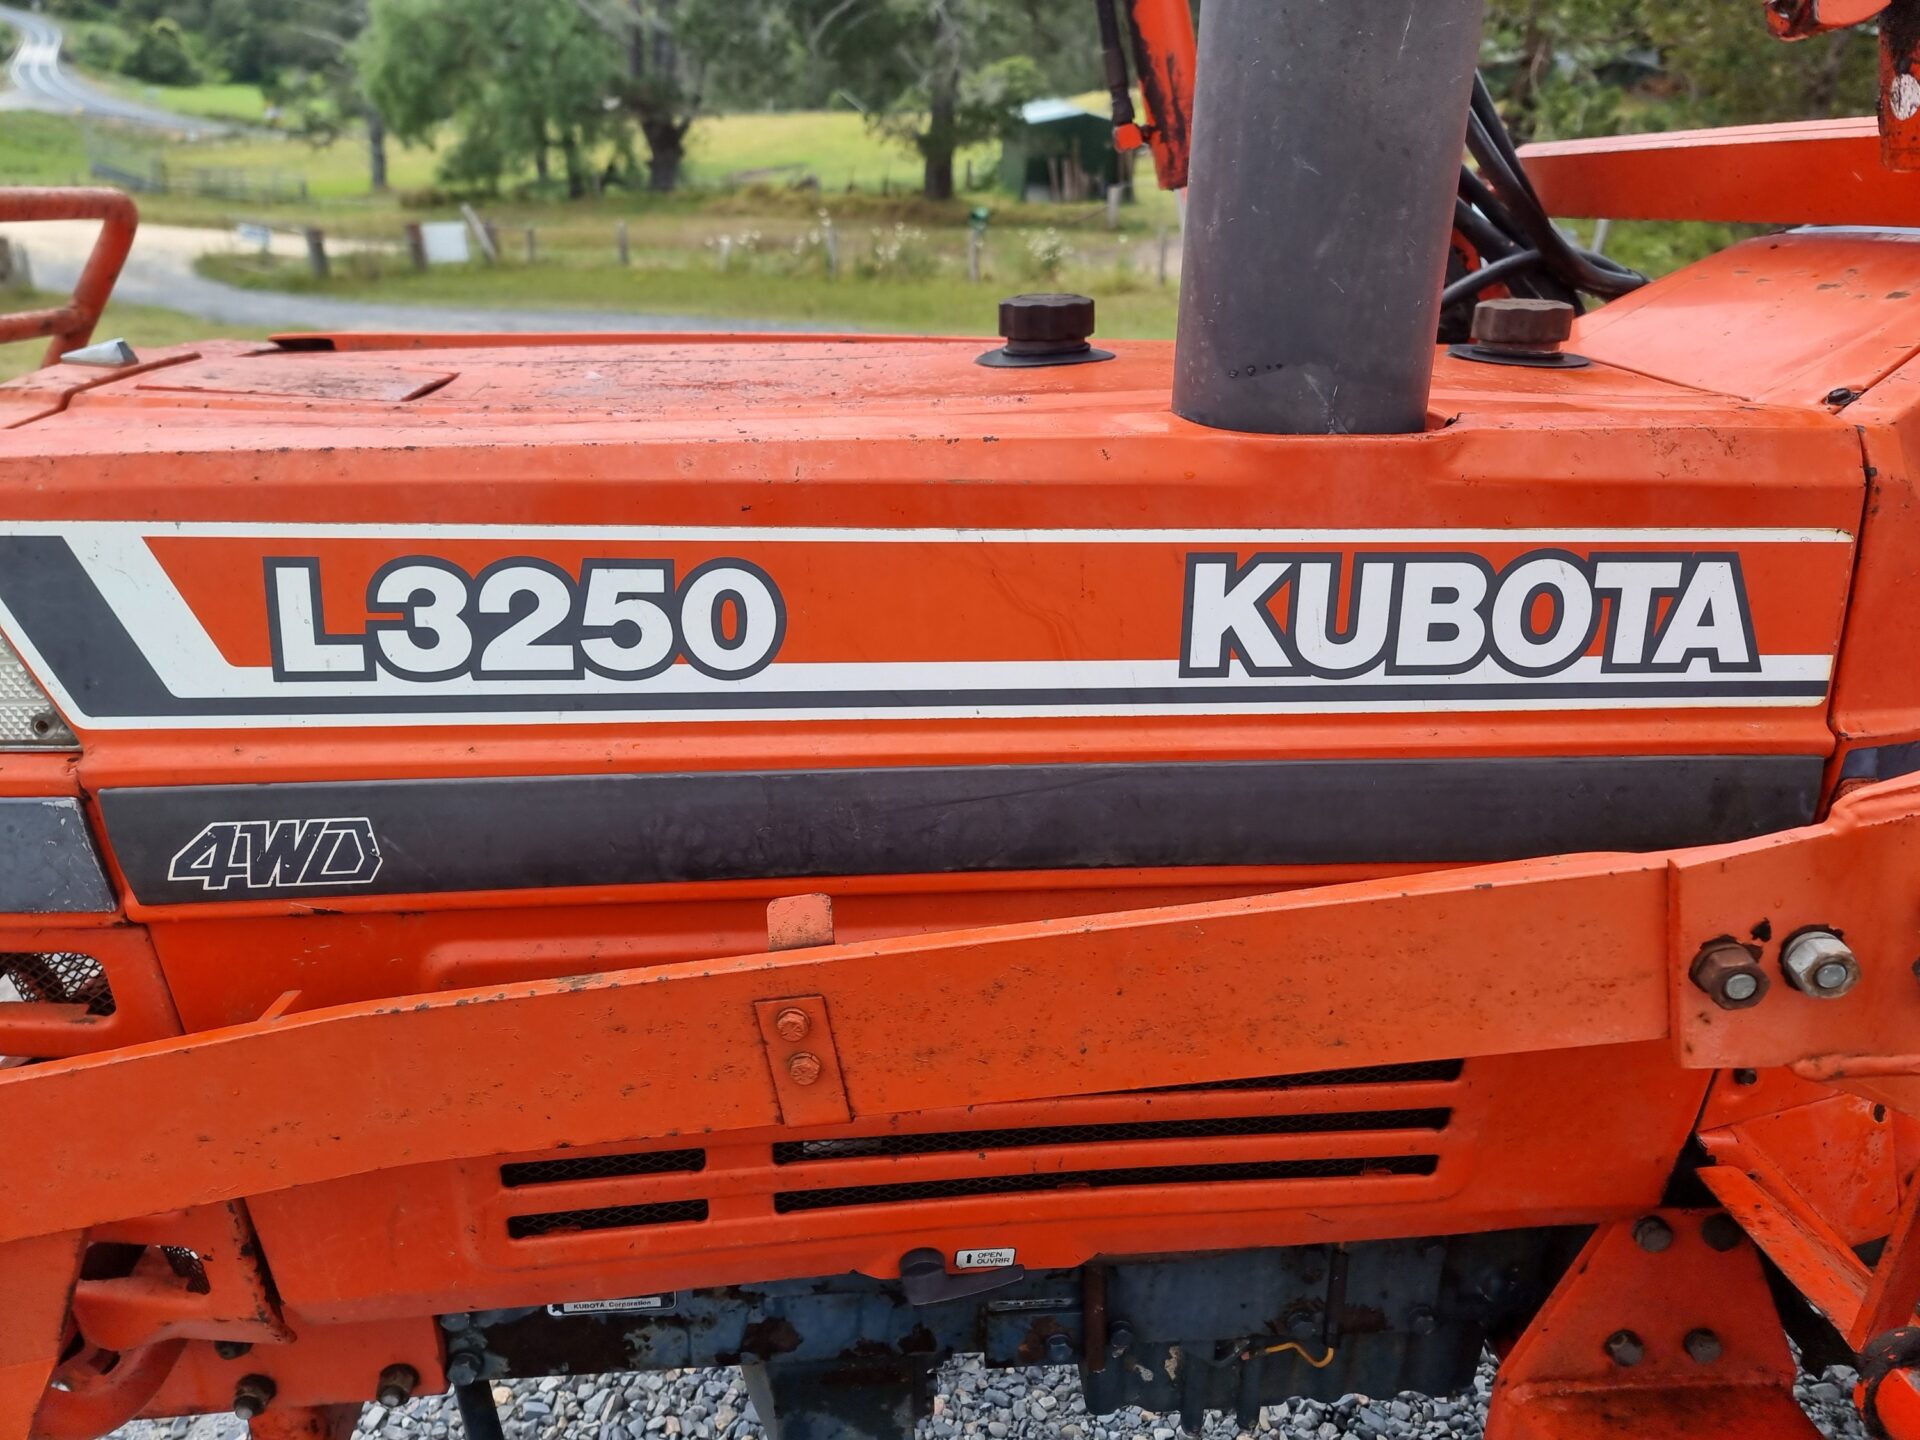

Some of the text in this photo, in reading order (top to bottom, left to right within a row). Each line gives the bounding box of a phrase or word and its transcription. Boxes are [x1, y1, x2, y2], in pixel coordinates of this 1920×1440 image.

[264, 556, 786, 682] L3250
[1179, 548, 1762, 679] KUBOTA
[168, 817, 383, 890] 4WD
[608, 1300, 652, 1308] Corporation
